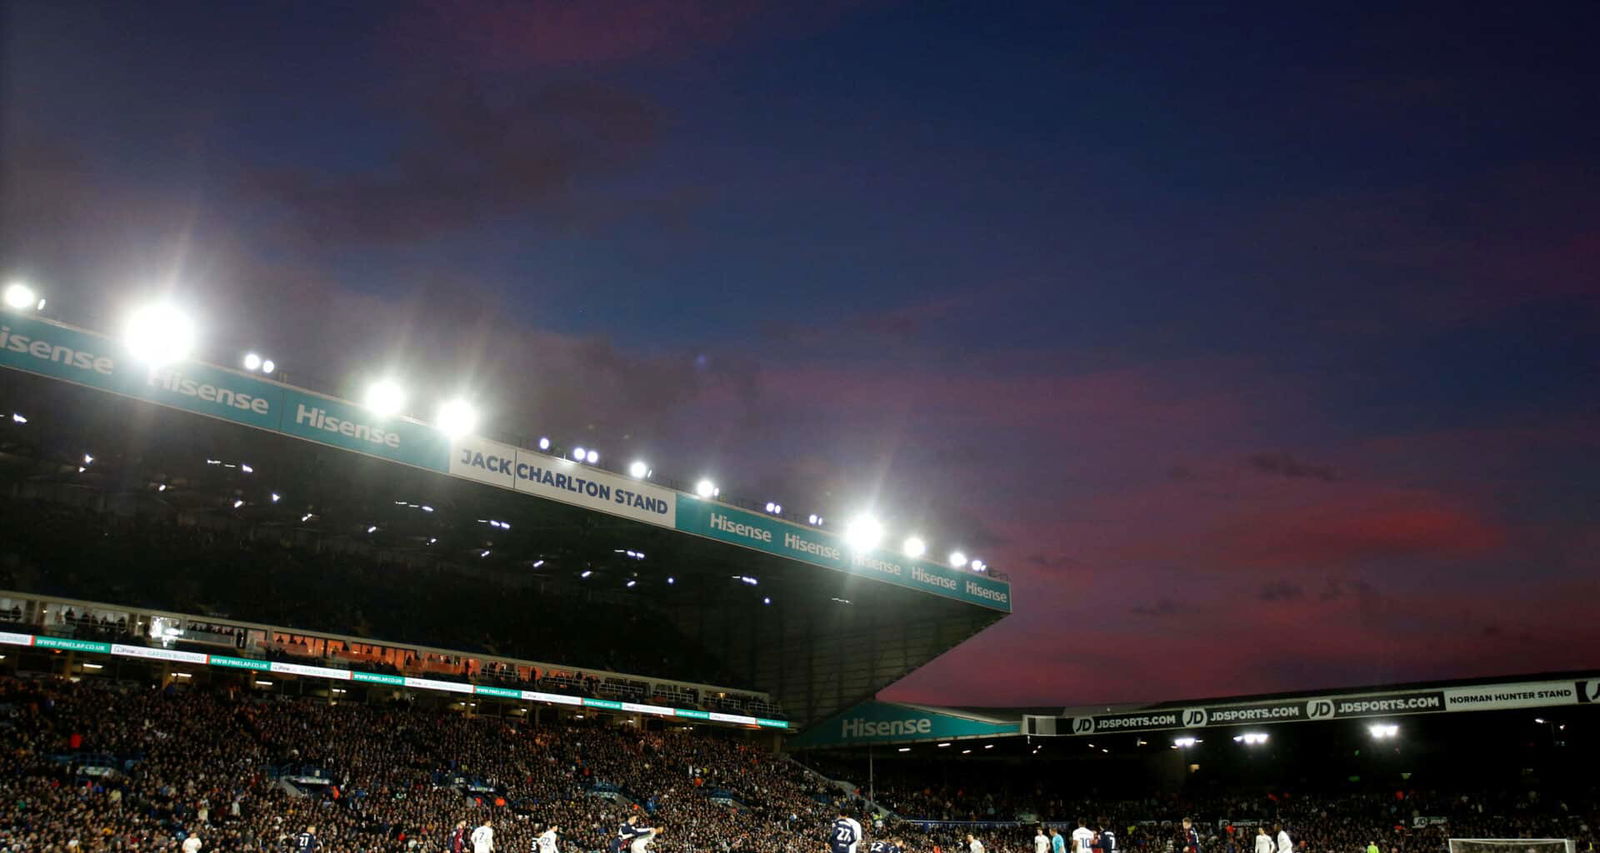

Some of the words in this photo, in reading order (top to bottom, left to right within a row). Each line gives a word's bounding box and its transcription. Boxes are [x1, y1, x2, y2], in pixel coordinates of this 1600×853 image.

[0, 327, 114, 375] isense
[296, 404, 400, 448] Hisense
[461, 449, 512, 476] JACK
[516, 463, 611, 500] CHARLTON
[615, 489, 668, 515] STAND
[710, 513, 772, 543] Hisense
[784, 533, 841, 560] Hisense
[911, 566, 957, 590] Hisense
[966, 581, 1008, 603] Hisense
[1310, 701, 1331, 717] JD
[1338, 696, 1440, 713] JDSPORTS.COM
[1449, 694, 1493, 704] NORMAN
[1494, 691, 1535, 701] HUNTER
[1537, 689, 1572, 699] STAND
[1076, 719, 1092, 732] JD
[1097, 714, 1176, 729] JDSPORTS.COM
[1186, 710, 1204, 726] JD
[1210, 706, 1299, 721] JDSPORTS.COM
[841, 718, 931, 738] Hisense
[837, 827, 851, 841] 27
